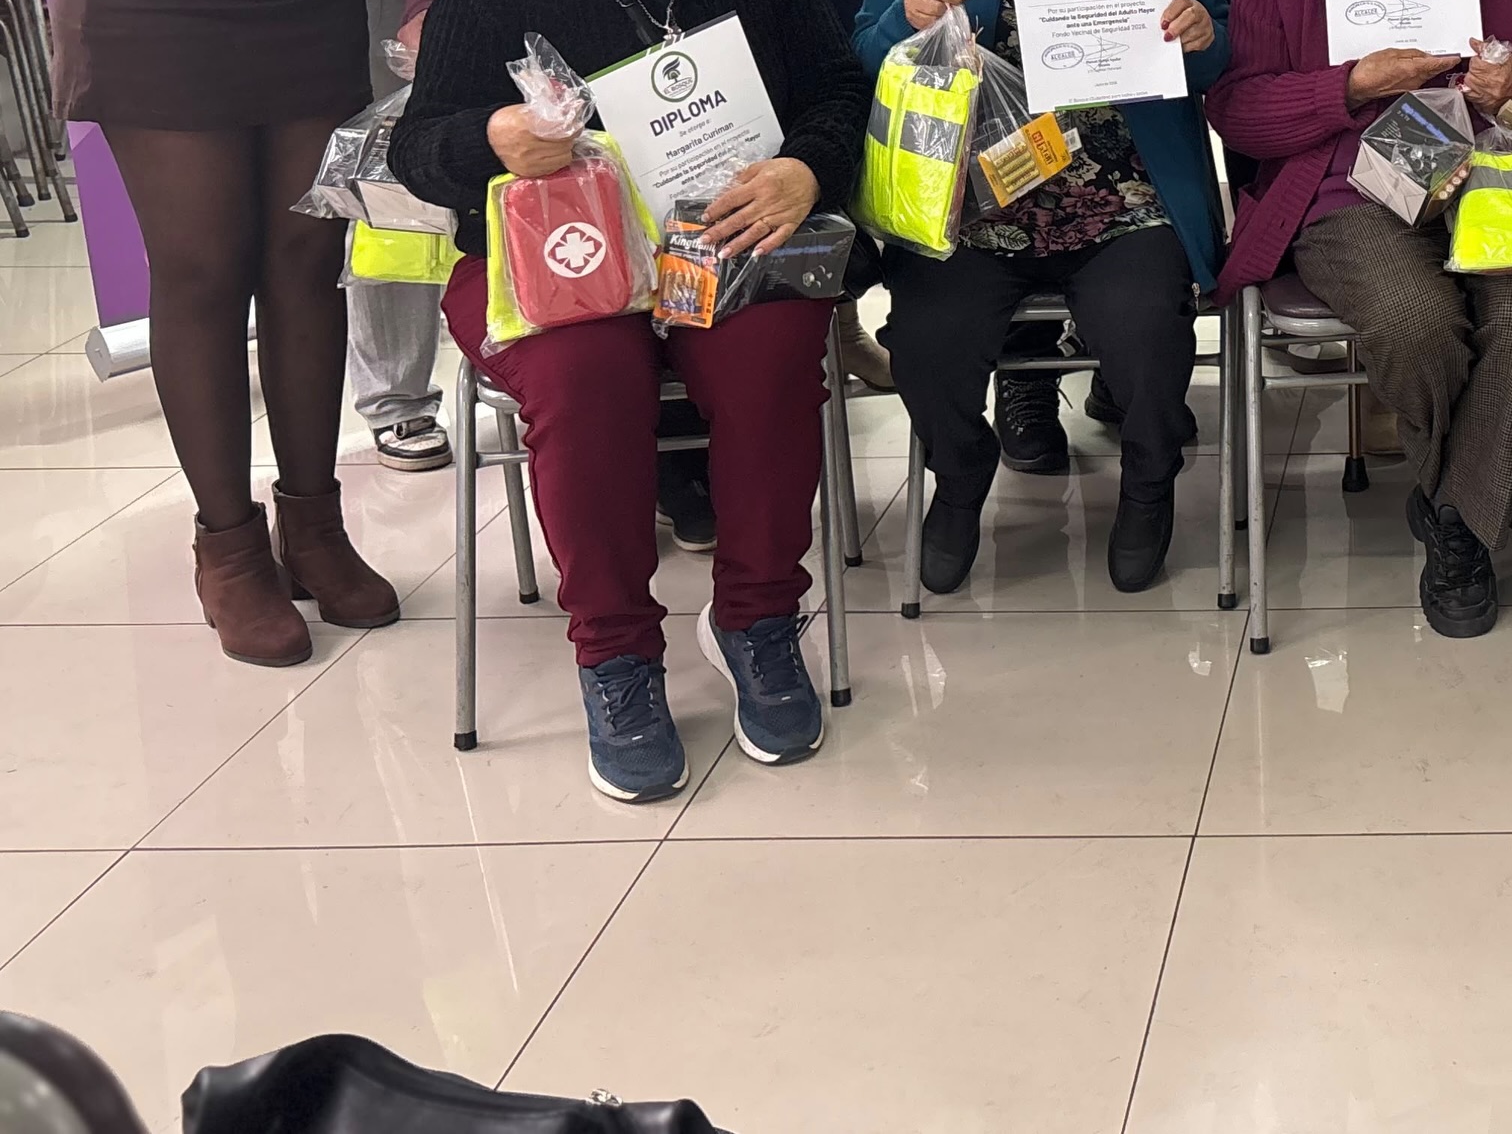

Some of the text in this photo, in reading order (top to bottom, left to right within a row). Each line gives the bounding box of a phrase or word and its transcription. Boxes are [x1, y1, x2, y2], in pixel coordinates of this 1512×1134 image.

[1077, 11, 1107, 20] Seguridad
[1101, 25, 1130, 34] Seguridad
[650, 90, 727, 136] DIPLOMA
[666, 138, 703, 159] Margarita
